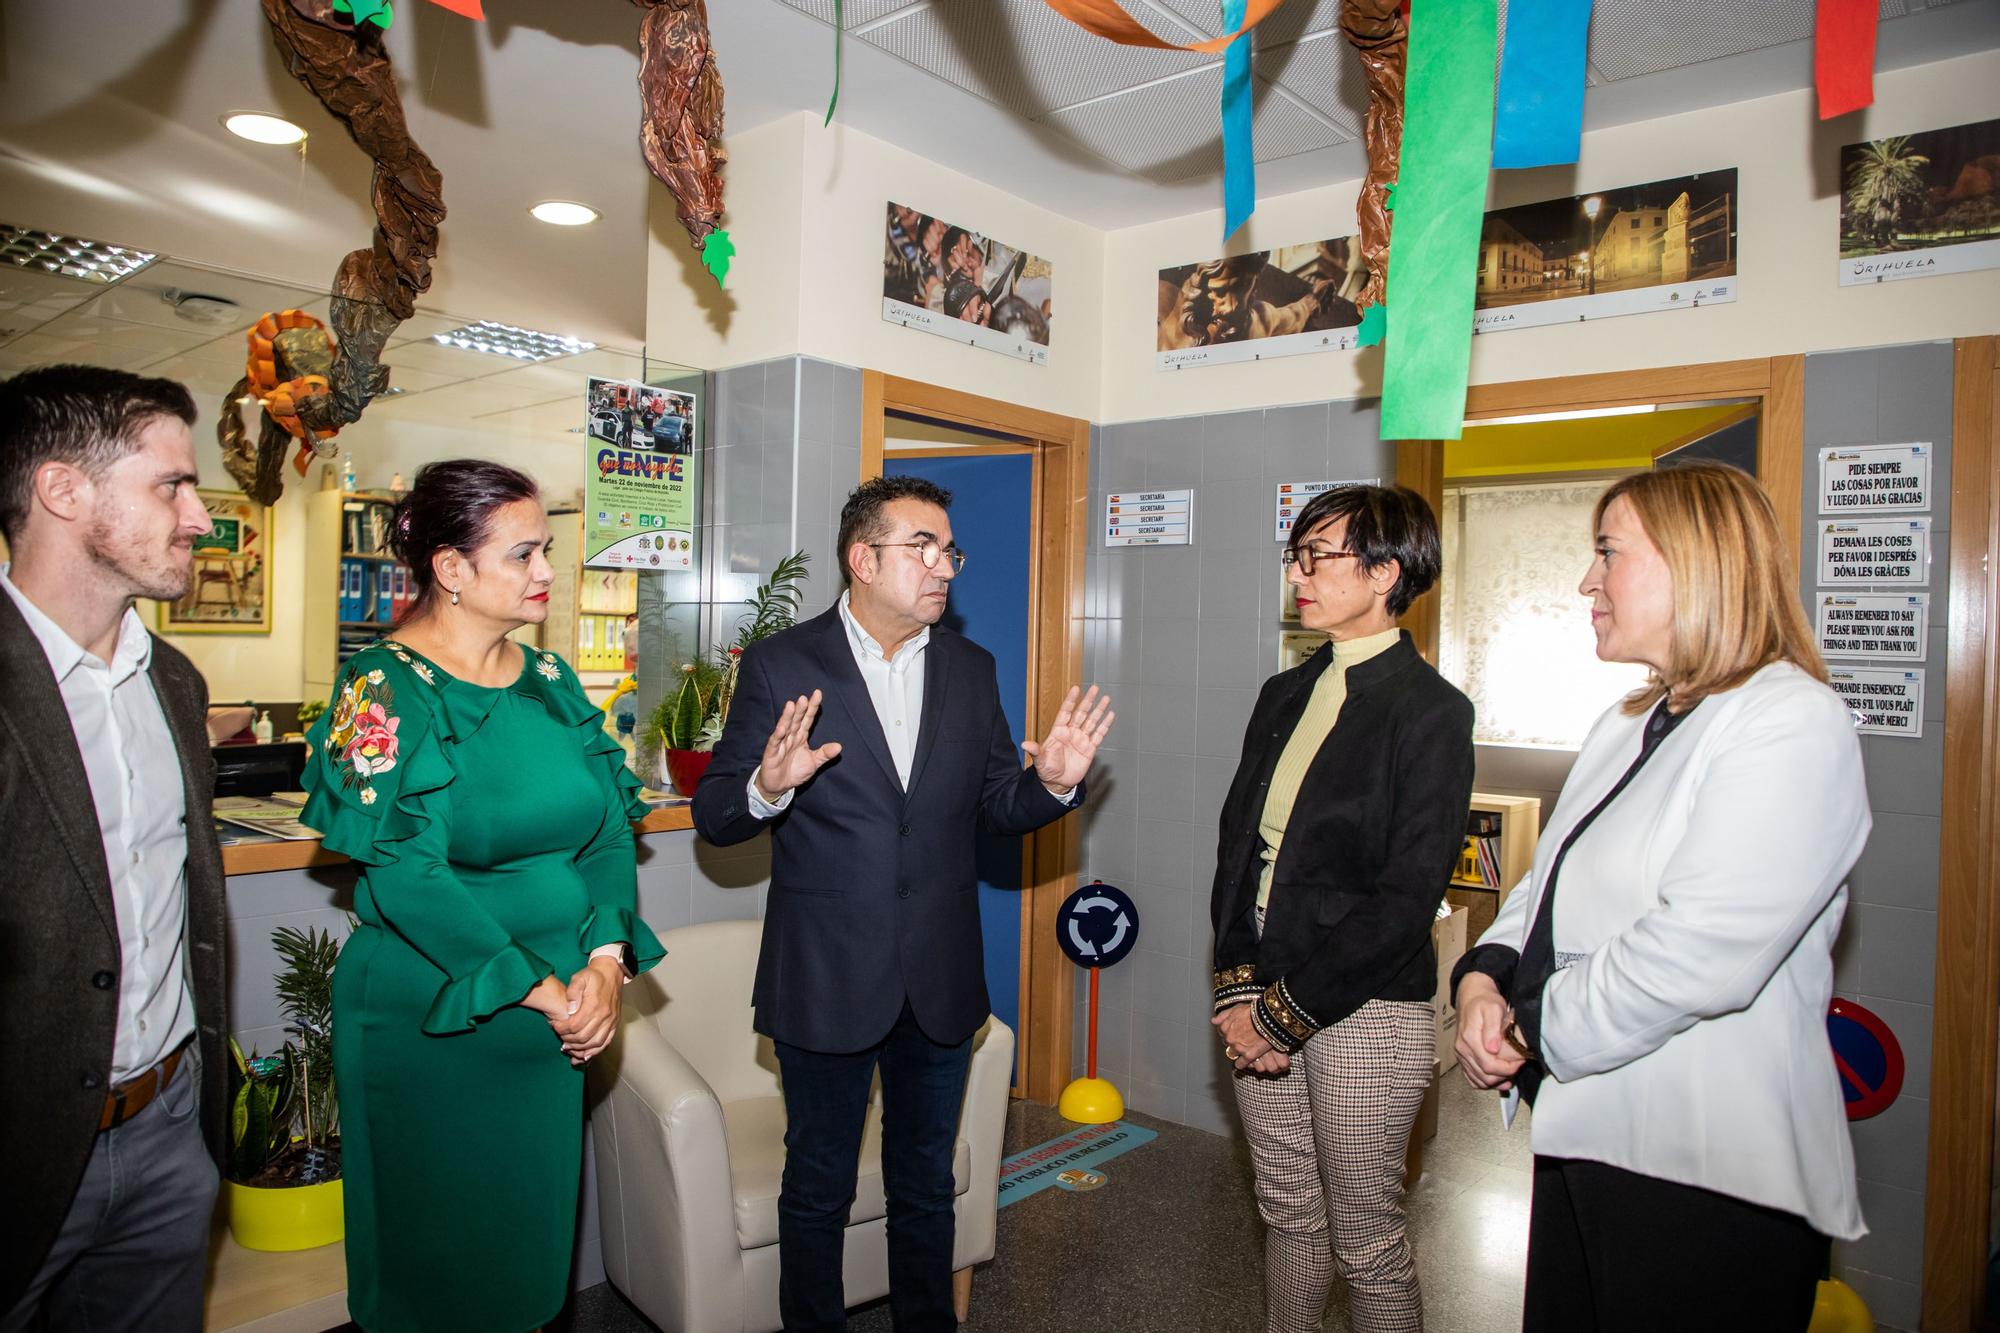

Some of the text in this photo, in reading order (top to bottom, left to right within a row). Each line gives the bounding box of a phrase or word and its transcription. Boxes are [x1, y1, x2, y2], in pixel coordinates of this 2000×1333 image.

[1854, 259, 1935, 275] ORIHUELA
[1473, 314, 1515, 324] IHUELA
[598, 449, 683, 482] GENTE
[1848, 462, 1901, 475] PIDE SIEMPRE
[1832, 477, 1918, 491] LAS COSAS POR FAVOR
[1827, 492, 1922, 506] Y LUEGO DA LAS GRACIAS
[1833, 536, 1912, 548] DEMANA LES COSES
[1828, 549, 1916, 562] PER FAVOR I DESPRÉS
[1858, 567, 1872, 577] LES
[1875, 564, 1910, 577] GRÀCIES
[1828, 610, 1853, 620] ALWAYS
[1891, 611, 1900, 621] TO
[1901, 611, 1915, 621] SAY
[1827, 625, 1914, 636] PLEASE WHEN YOU ASK FOR
[1824, 640, 1917, 652] THINGS AND THEN THANK YOU
[1862, 684, 1906, 696] ENSEMENCEZ
[1862, 699, 1874, 709] S'IL
[1876, 700, 1894, 710] VOUS
[1886, 716, 1908, 727] MERCI
[1065, 1132, 1128, 1161] HURCHILLO
